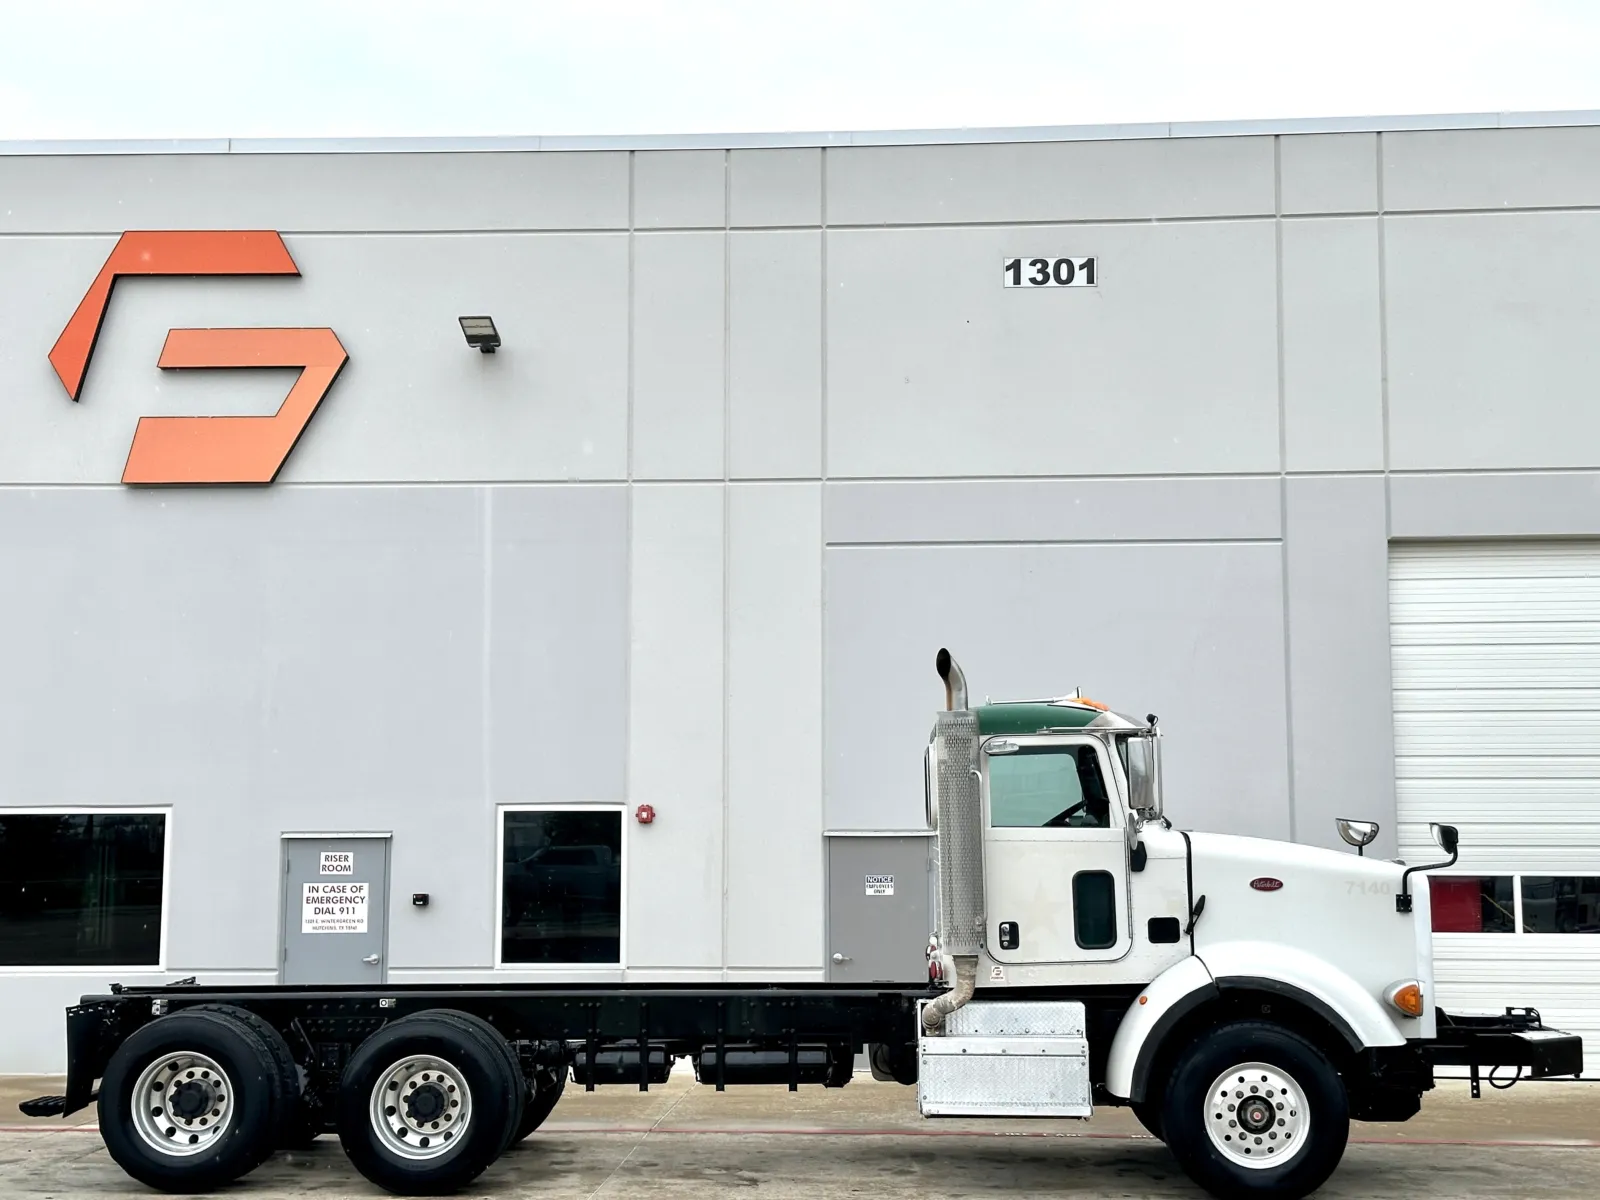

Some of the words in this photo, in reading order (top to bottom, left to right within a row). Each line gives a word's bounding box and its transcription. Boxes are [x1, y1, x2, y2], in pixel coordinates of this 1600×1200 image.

[1005, 257, 1095, 286] 1301
[324, 854, 350, 862] RISER
[1346, 881, 1390, 894] 7140
[306, 896, 366, 904] EMERGENCY
